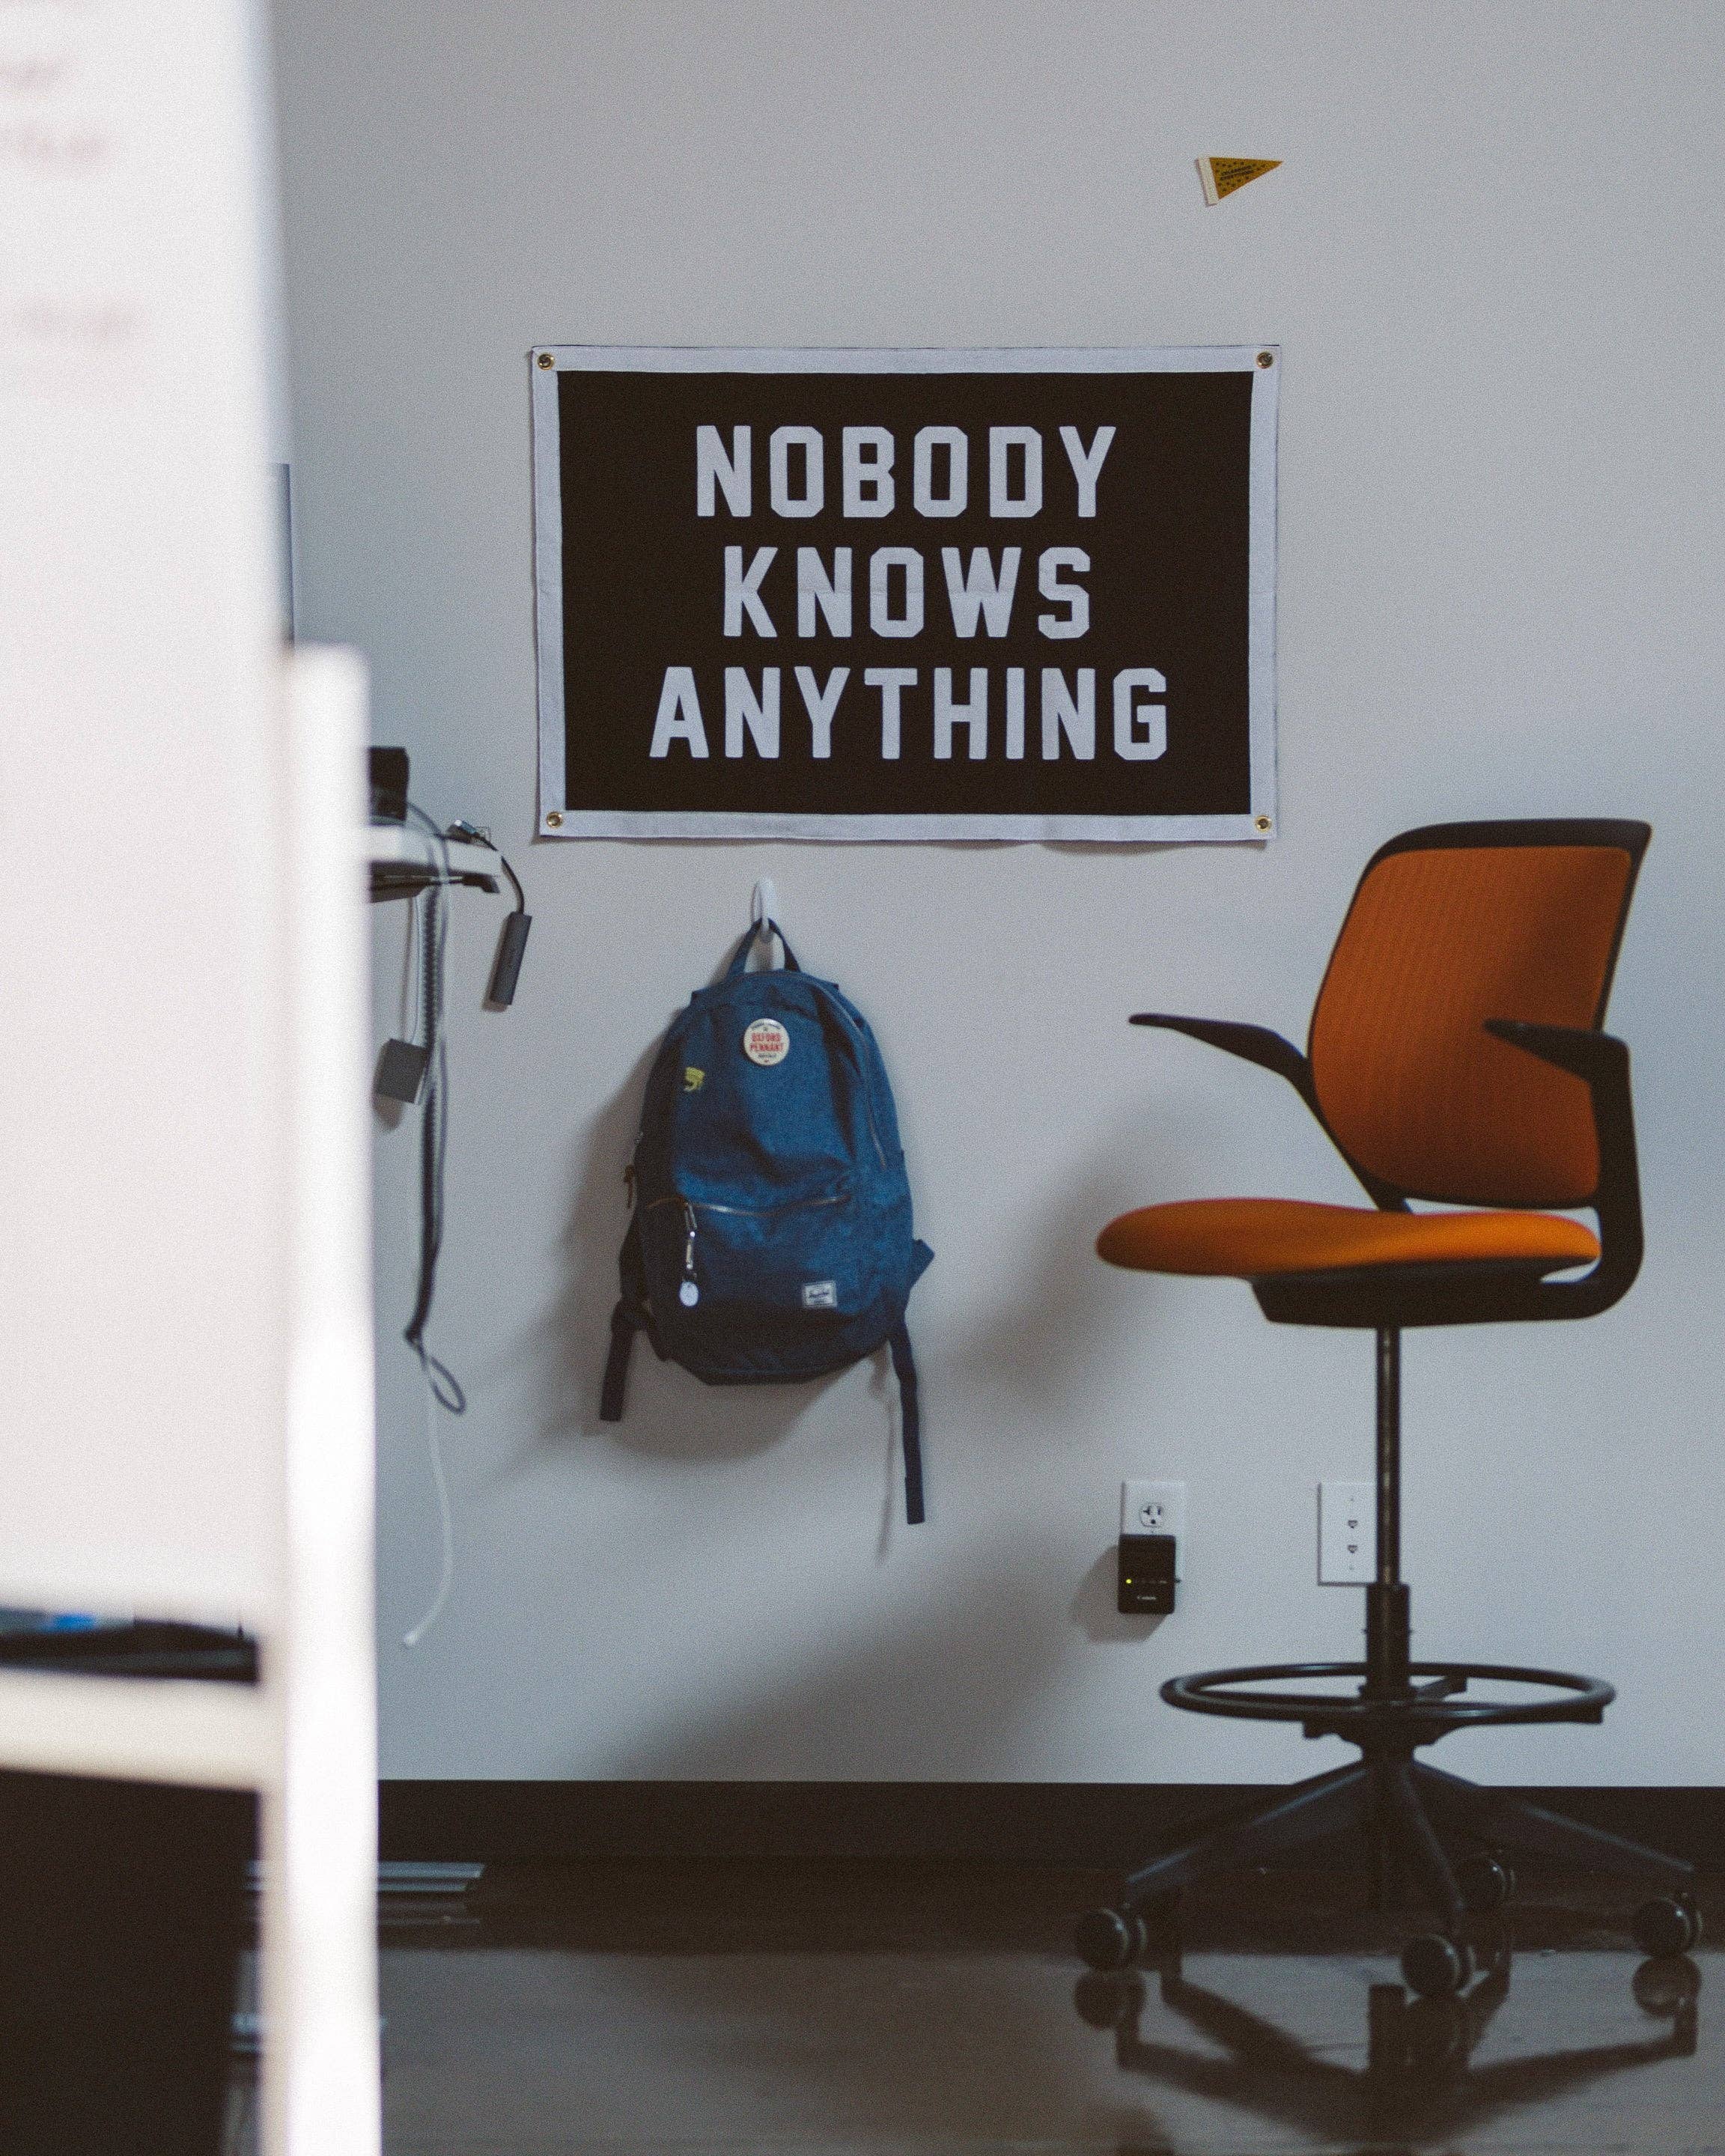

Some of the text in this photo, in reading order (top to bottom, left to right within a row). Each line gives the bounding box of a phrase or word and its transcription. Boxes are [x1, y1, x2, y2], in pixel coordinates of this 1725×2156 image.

[696, 425, 1116, 518] NOBODY
[723, 546, 1090, 639] KNOWS
[649, 666, 1166, 761] ANYTHING
[749, 1043, 784, 1052] PENNANT
